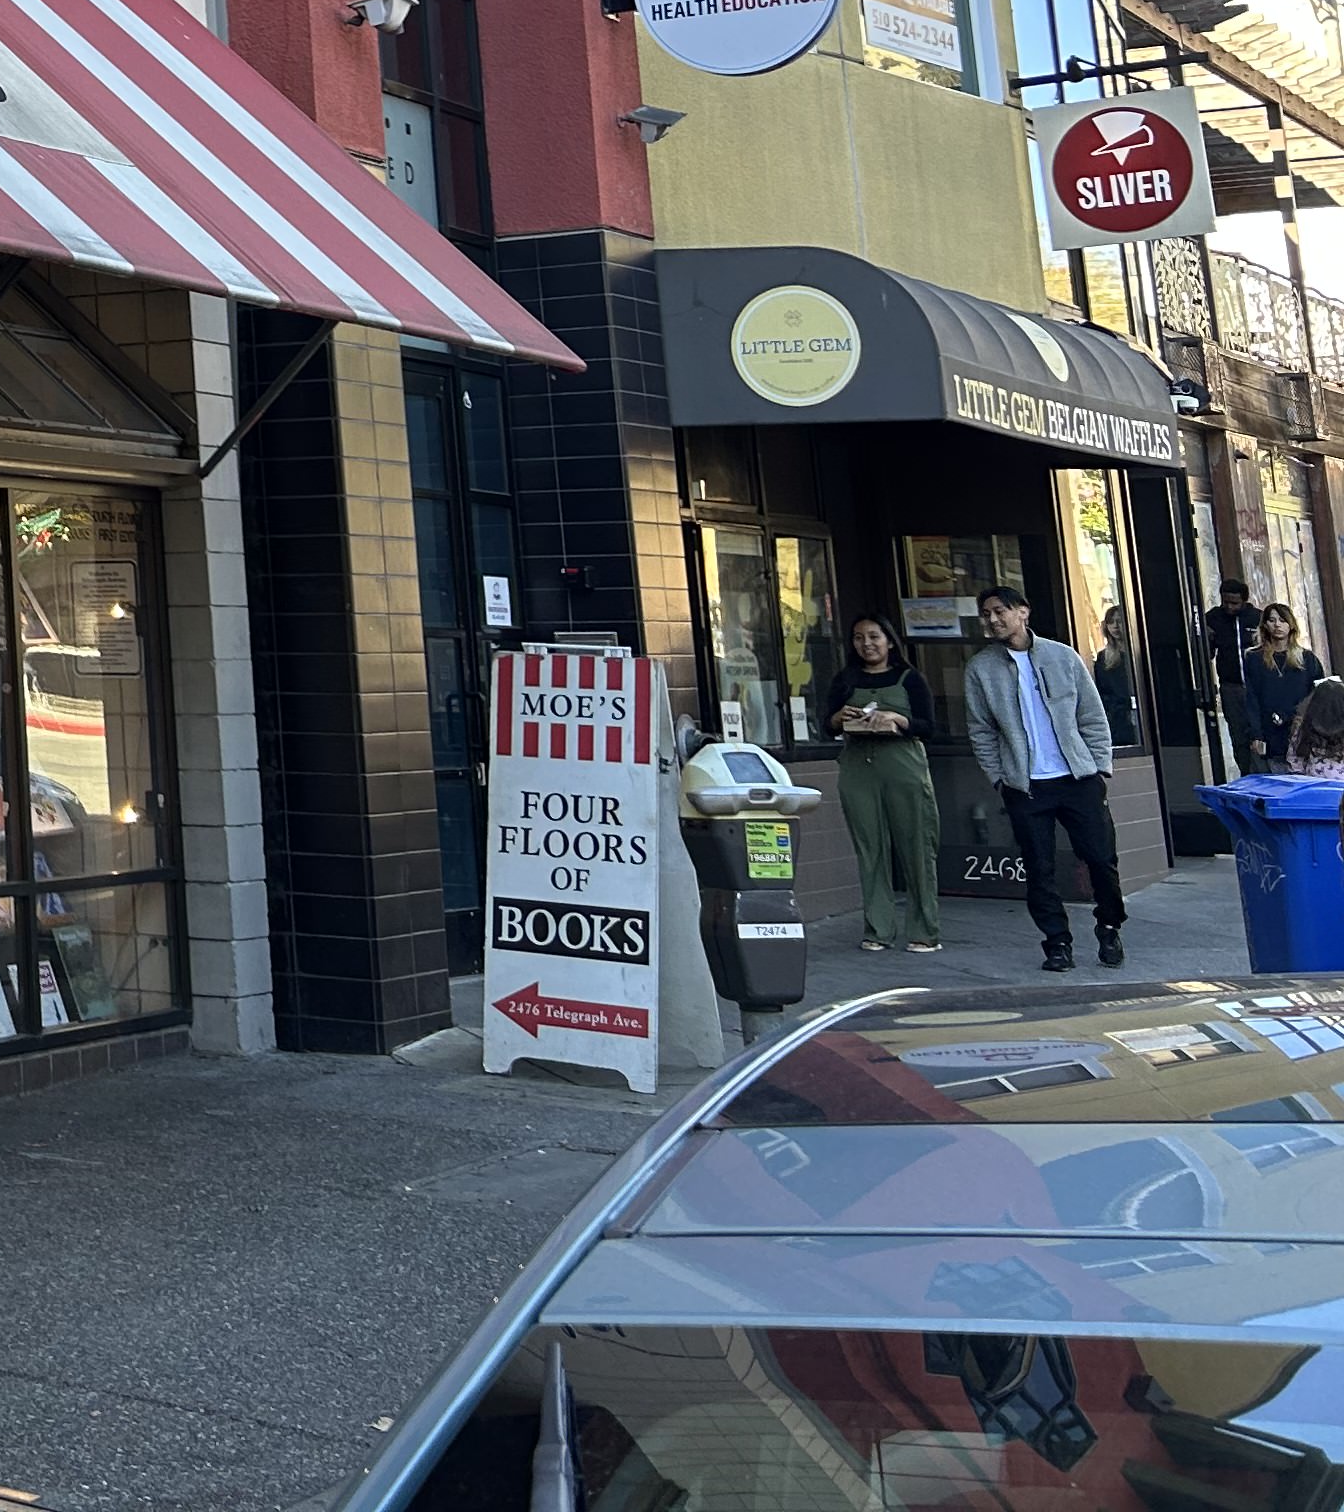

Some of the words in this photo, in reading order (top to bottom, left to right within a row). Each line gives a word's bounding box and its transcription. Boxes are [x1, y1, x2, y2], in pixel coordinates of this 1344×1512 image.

[872, 8, 890, 28] 510
[893, 15, 955, 52] 524-2344
[1076, 167, 1174, 212] SLIVER
[741, 339, 805, 355] LITTLE
[808, 338, 853, 353] GEM
[953, 374, 1011, 430] LITTLE
[1011, 391, 1046, 438] GEM
[1046, 399, 1111, 451] BELGIAN
[1110, 413, 1172, 461] WAFFLES
[520, 692, 627, 722] MOE'S
[520, 790, 623, 827] FOUR
[498, 825, 648, 866] FLOORS
[550, 867, 591, 893] OF
[963, 855, 1027, 882] 2468
[497, 904, 646, 956] BOOKS
[754, 925, 788, 937] T2474
[507, 999, 541, 1016] 2476
[544, 1002, 609, 1027] Telegraph
[611, 1010, 643, 1030] Ave.
